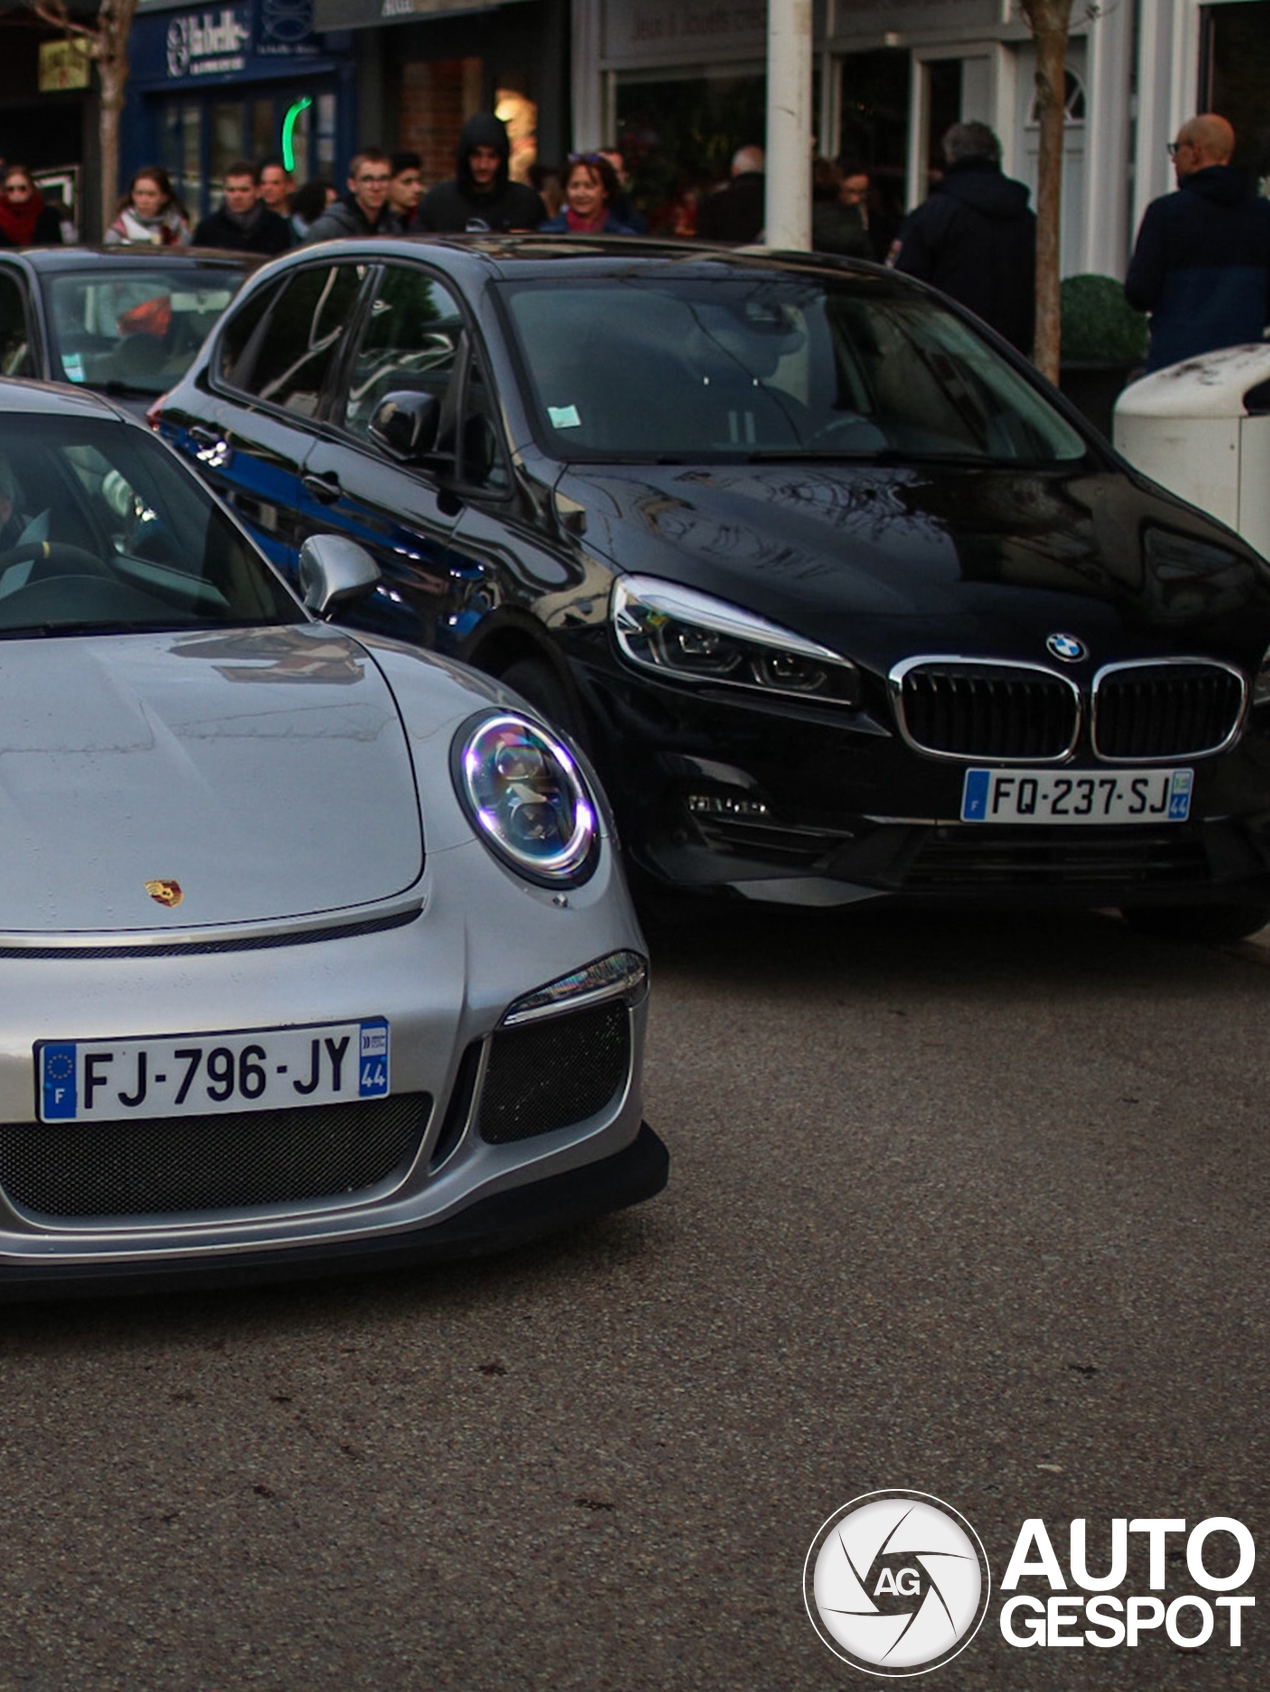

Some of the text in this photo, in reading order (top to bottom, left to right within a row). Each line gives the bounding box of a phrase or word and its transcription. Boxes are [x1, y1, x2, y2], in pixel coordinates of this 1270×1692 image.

[991, 777, 1171, 815] FQ-237-SJ
[84, 1036, 351, 1109] FJ-796-JY
[361, 1062, 386, 1088] 44
[55, 1088, 65, 1104] F
